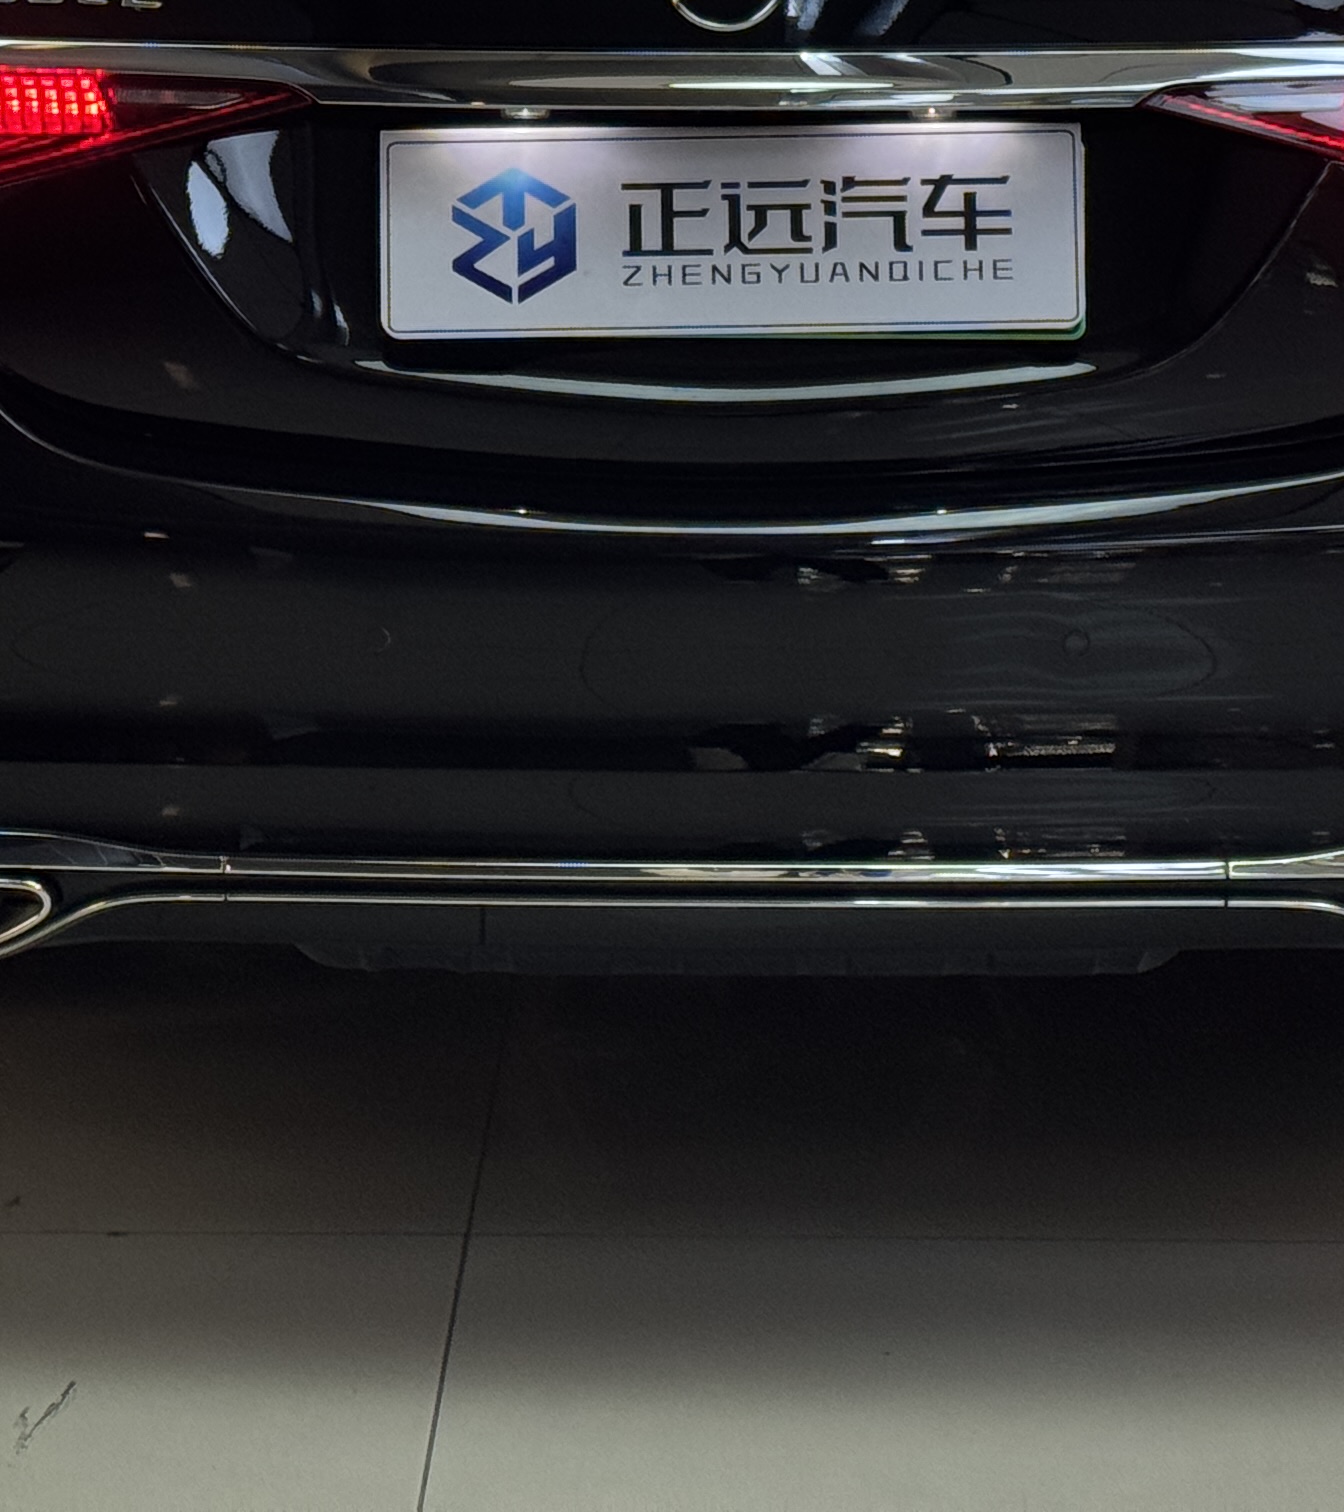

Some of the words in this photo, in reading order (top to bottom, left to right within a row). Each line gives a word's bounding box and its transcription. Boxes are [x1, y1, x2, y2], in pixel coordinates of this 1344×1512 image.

[620, 174, 1013, 257] 正远汽车
[622, 258, 1014, 287] ZHENGYUANQICHE
